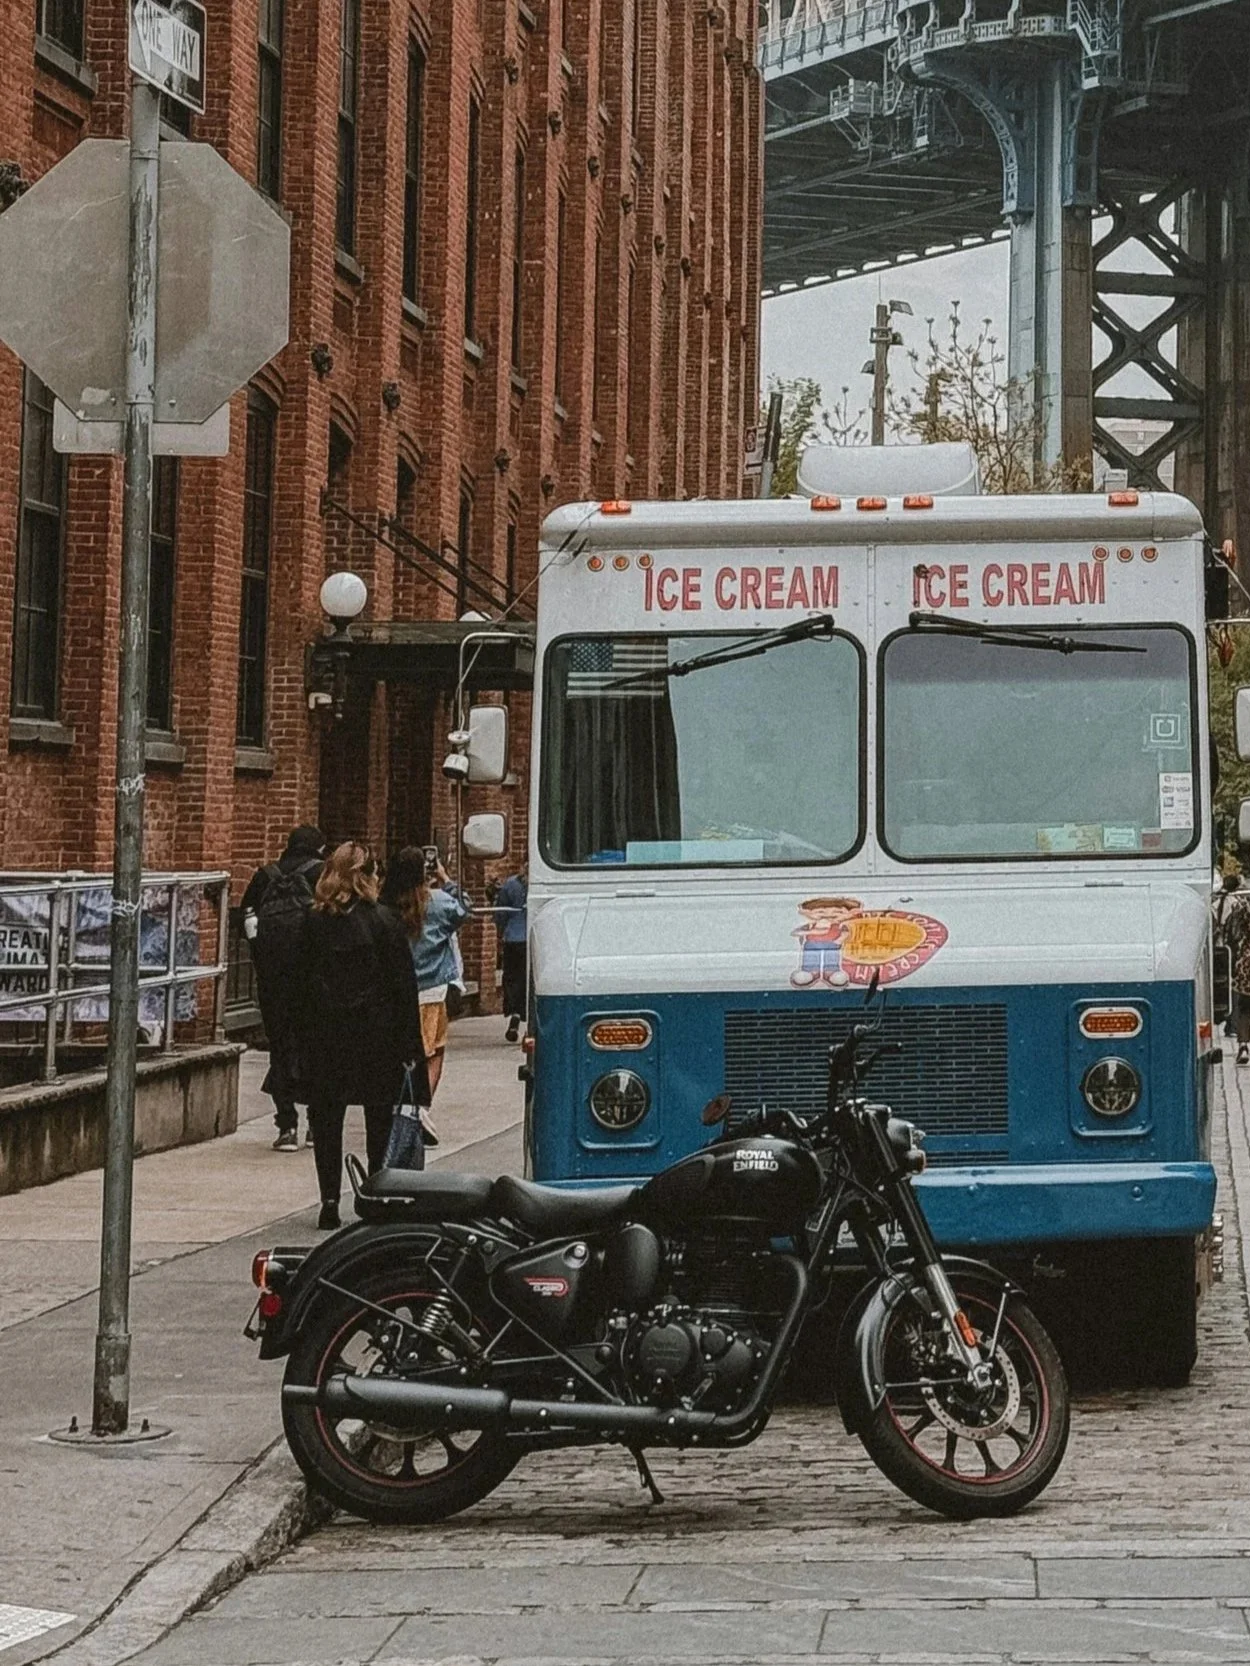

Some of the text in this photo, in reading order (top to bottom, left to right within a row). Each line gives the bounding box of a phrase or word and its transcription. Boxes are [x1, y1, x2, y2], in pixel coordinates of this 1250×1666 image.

[142, 0, 196, 73] ONE WAY
[644, 566, 839, 611] ICE CREAM
[913, 561, 1106, 608] ICE CREAM
[733, 1160, 779, 1171] ENFIELD
[736, 1149, 775, 1160] ROYAL
